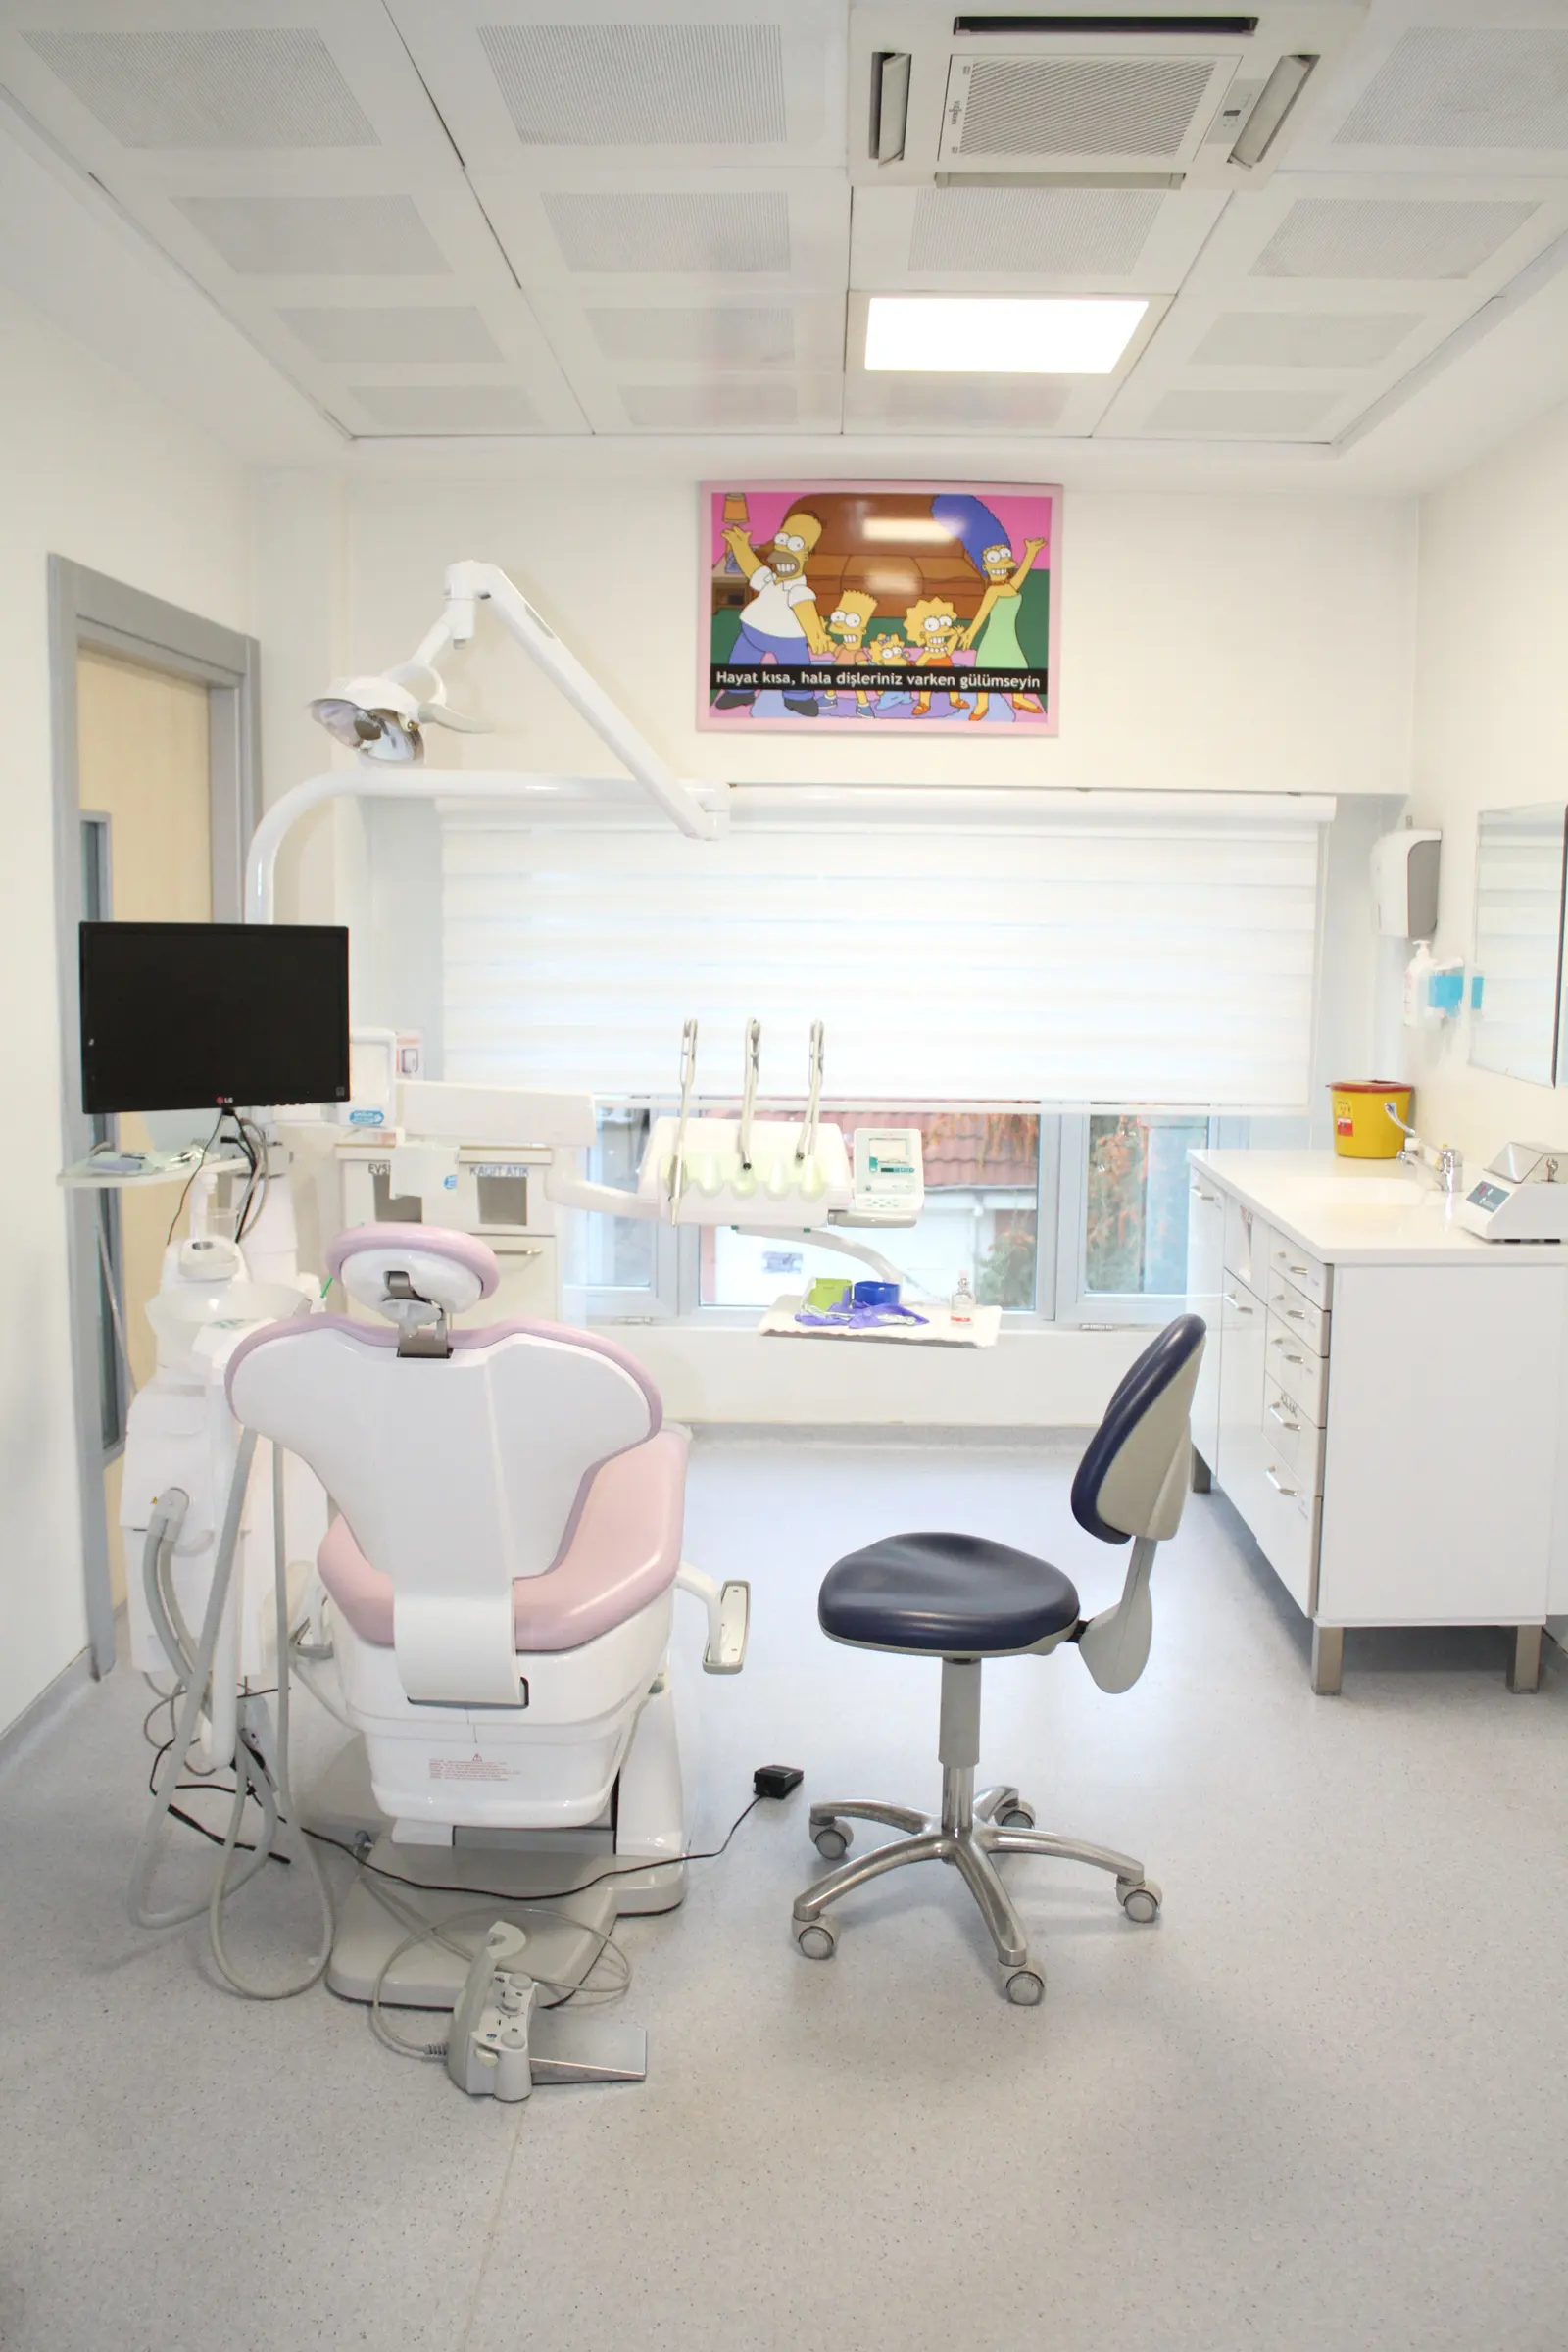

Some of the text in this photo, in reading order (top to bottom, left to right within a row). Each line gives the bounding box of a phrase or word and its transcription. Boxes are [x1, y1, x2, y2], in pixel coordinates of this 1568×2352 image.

[715, 670, 1041, 690] Hayat kısa, hala dişleriniz varken gülümseyin
